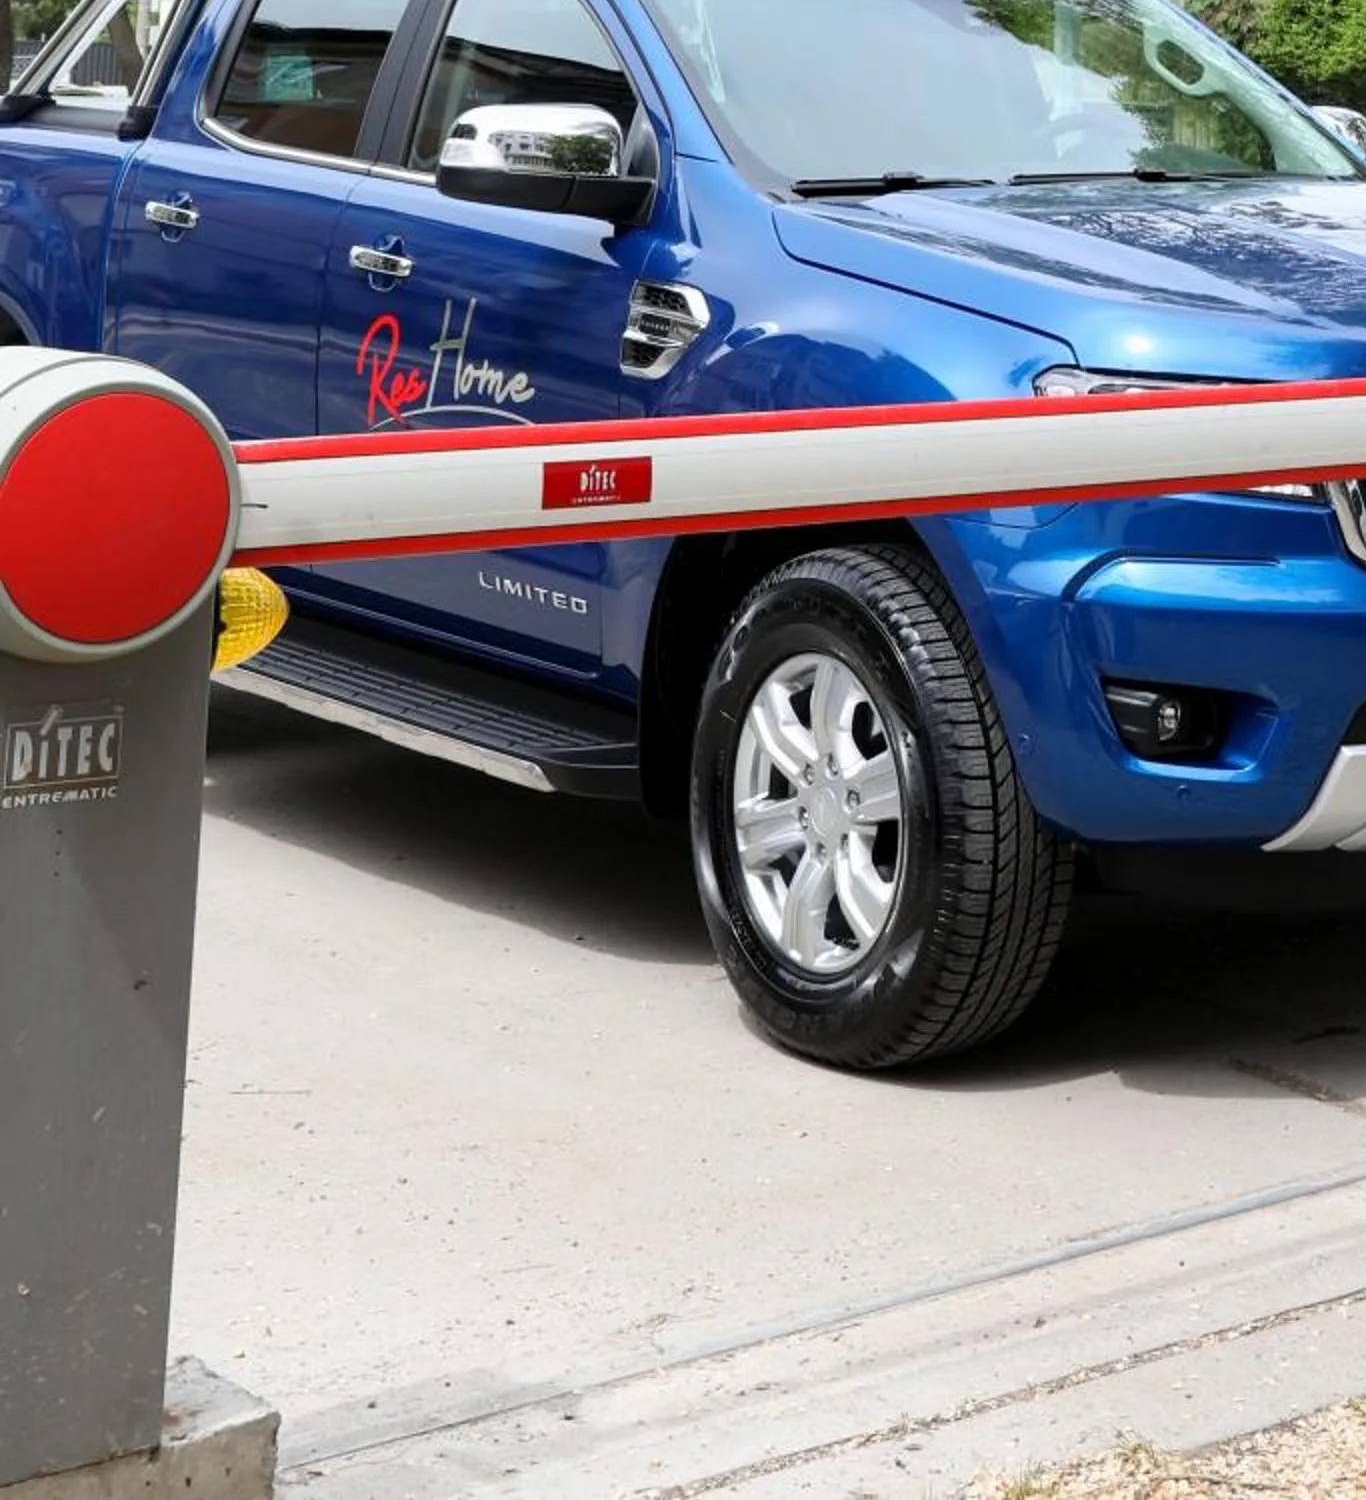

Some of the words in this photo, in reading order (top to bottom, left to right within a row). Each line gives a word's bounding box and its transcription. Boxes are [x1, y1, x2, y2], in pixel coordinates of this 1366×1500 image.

[428, 297, 535, 411] Home
[479, 571, 588, 615] LIMITED
[1, 786, 118, 809] ENTREMATIC
